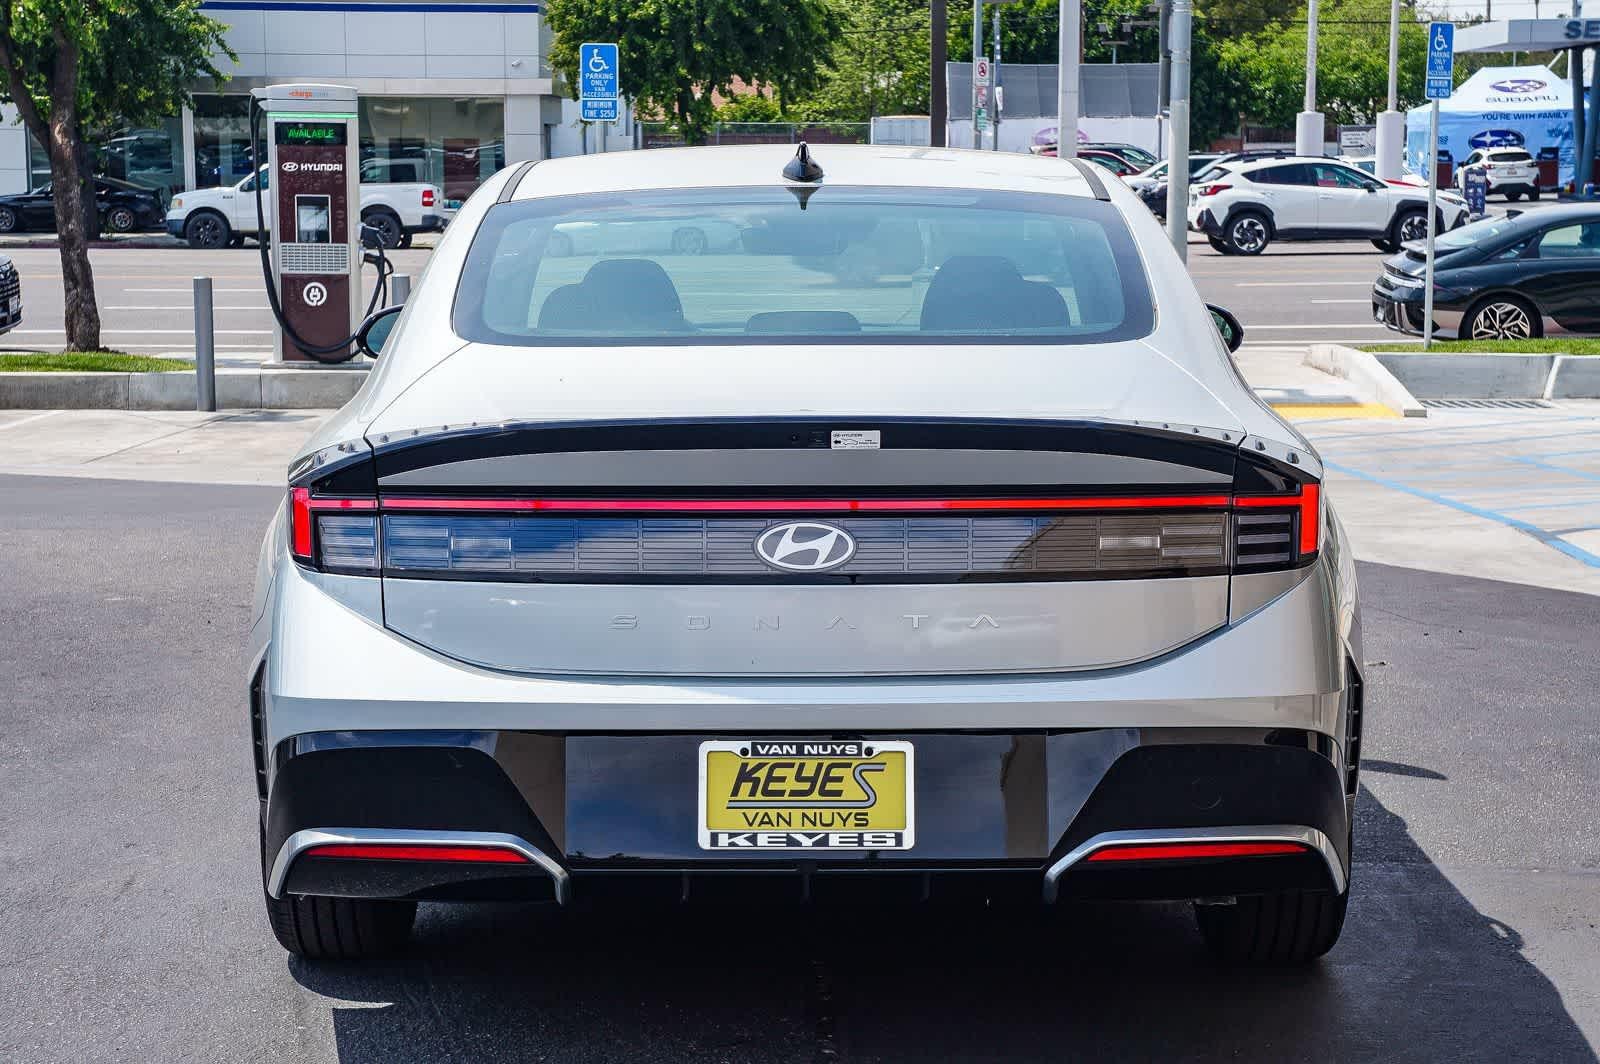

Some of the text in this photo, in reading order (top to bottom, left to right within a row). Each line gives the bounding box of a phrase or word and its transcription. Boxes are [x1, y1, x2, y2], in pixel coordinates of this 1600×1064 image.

[585, 72, 614, 80] PARKING
[587, 101, 612, 109] MINIMUM
[585, 109, 615, 118] FINE $250
[1481, 111, 1568, 120] YOU'RE WITH FAMILY
[288, 128, 335, 138] AVAILABLE
[301, 163, 343, 171] HYUNDAI
[608, 614, 1001, 631] SONATA
[756, 744, 858, 755] VAN NUYS
[728, 762, 887, 806] KEYES
[742, 811, 869, 827] VAN NUYS
[718, 833, 896, 847] KEYES
